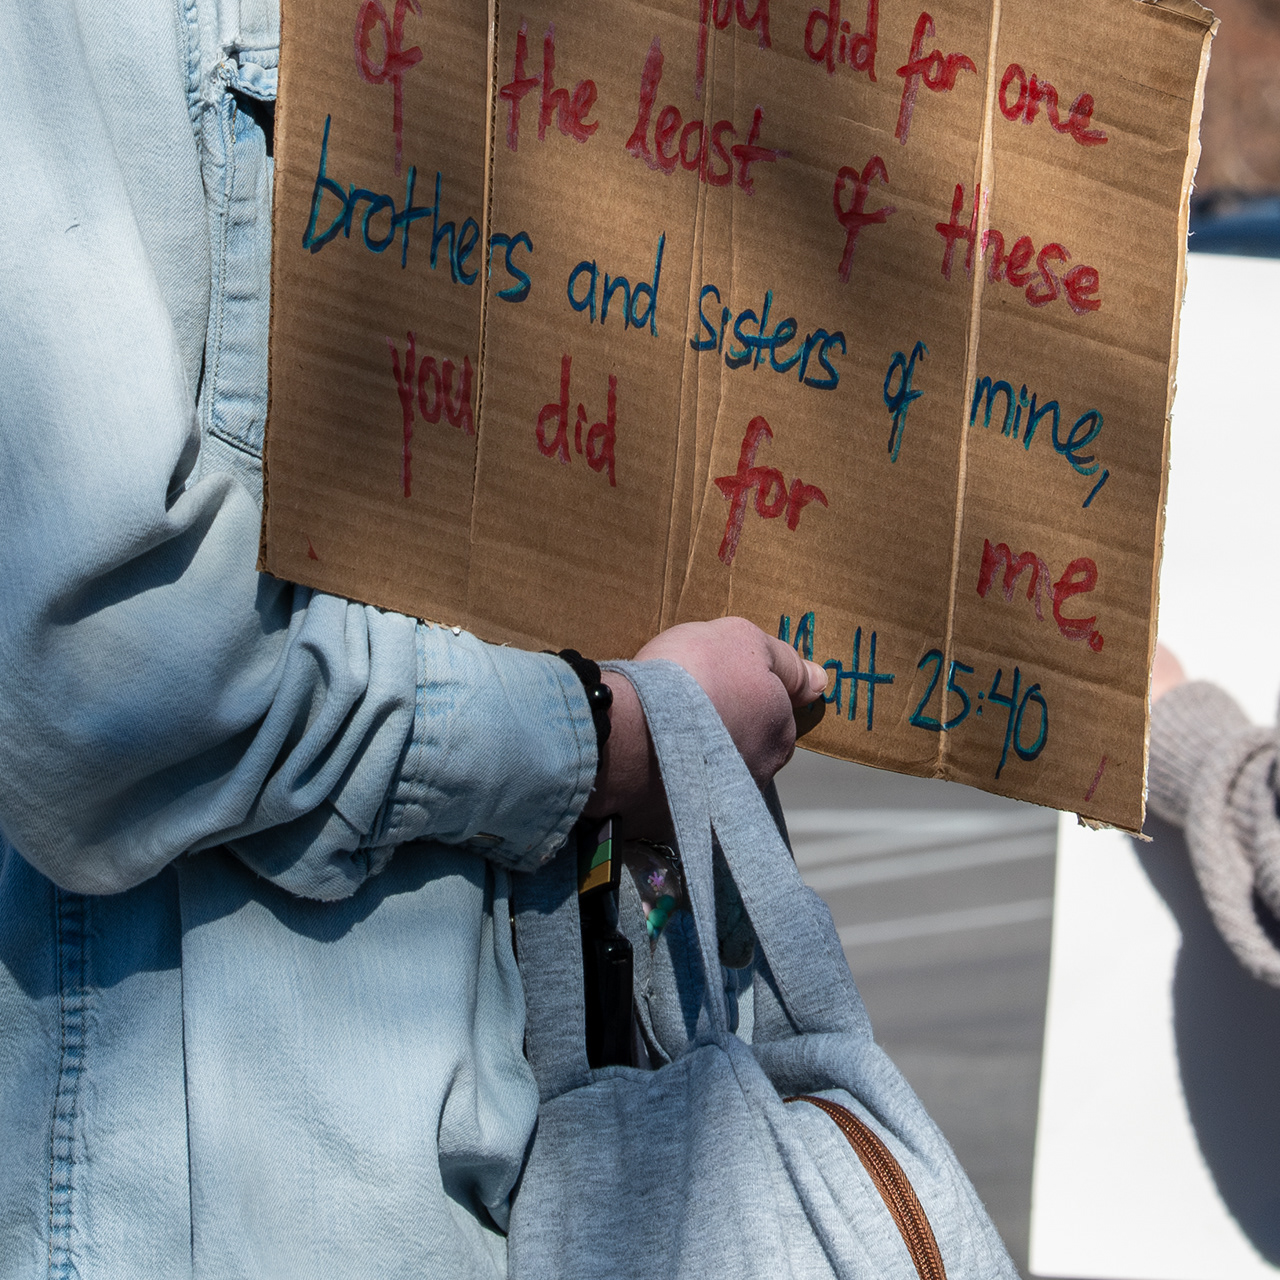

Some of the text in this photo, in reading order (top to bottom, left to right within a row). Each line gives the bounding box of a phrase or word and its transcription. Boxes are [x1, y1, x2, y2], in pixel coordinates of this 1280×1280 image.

[499, 23, 599, 152] the
[625, 35, 792, 197] least
[832, 154, 898, 284] of
[934, 182, 1102, 316] these
[896, 11, 978, 145] for
[998, 63, 1109, 146] one
[302, 113, 1111, 509] brothers and sisters of mine,
[385, 330, 1105, 653] you did for me.
[908, 647, 1049, 780] 25:40
